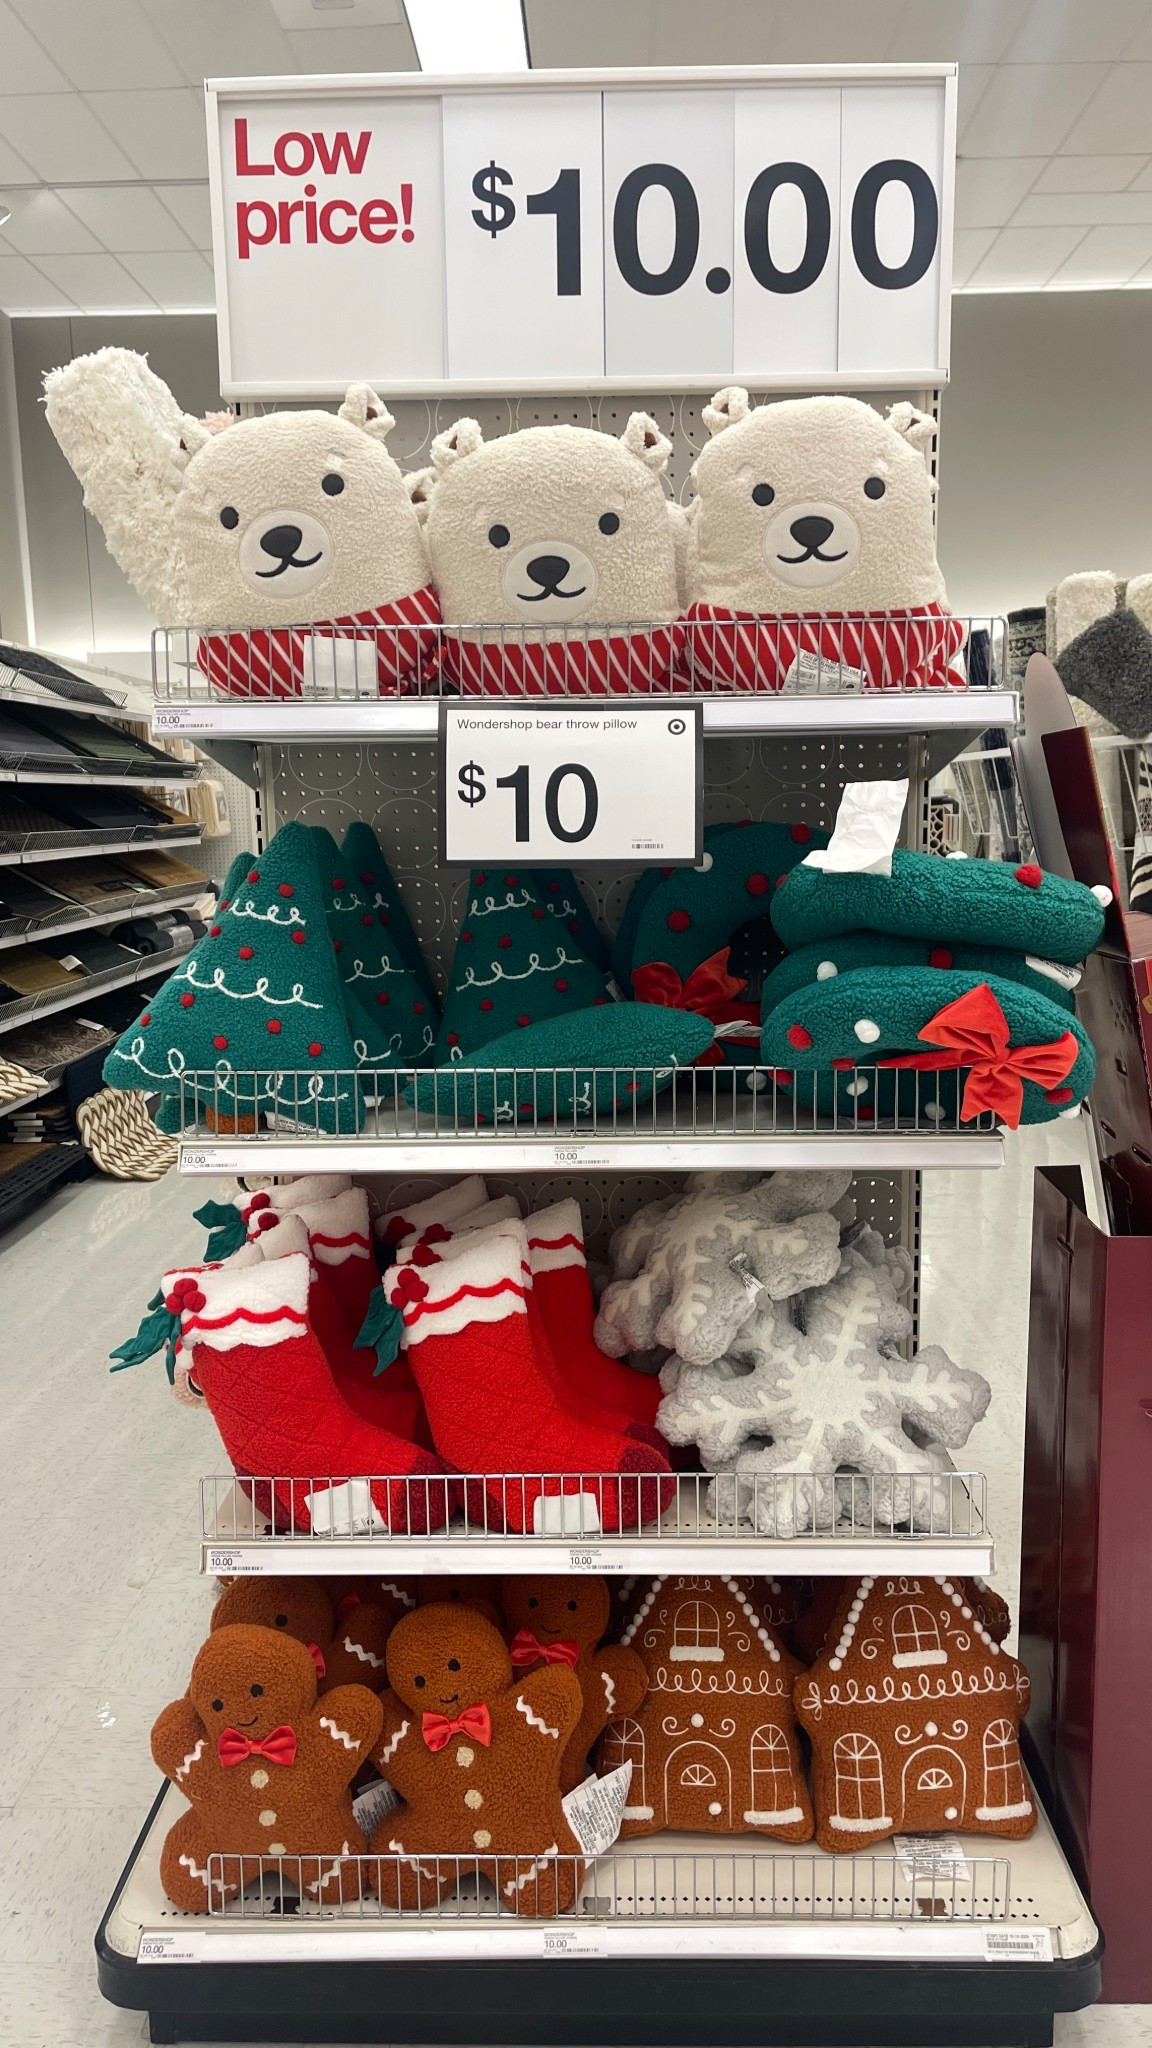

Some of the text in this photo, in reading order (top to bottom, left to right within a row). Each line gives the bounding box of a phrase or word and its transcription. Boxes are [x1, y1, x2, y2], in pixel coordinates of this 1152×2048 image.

[234, 117, 373, 177] Low
[236, 184, 415, 260] price!
[471, 159, 939, 297] $10.00
[156, 715, 180, 724] 10.00
[457, 718, 638, 731] Wondershop bear throw pillow
[457, 760, 599, 844] $10
[183, 1156, 206, 1164] 10.00
[555, 1152, 578, 1161] 10.00
[211, 1557, 233, 1566] 10.00
[570, 1556, 592, 1565] 10.00
[545, 1939, 567, 1948] 10.00
[142, 1945, 164, 1954] 10.00
